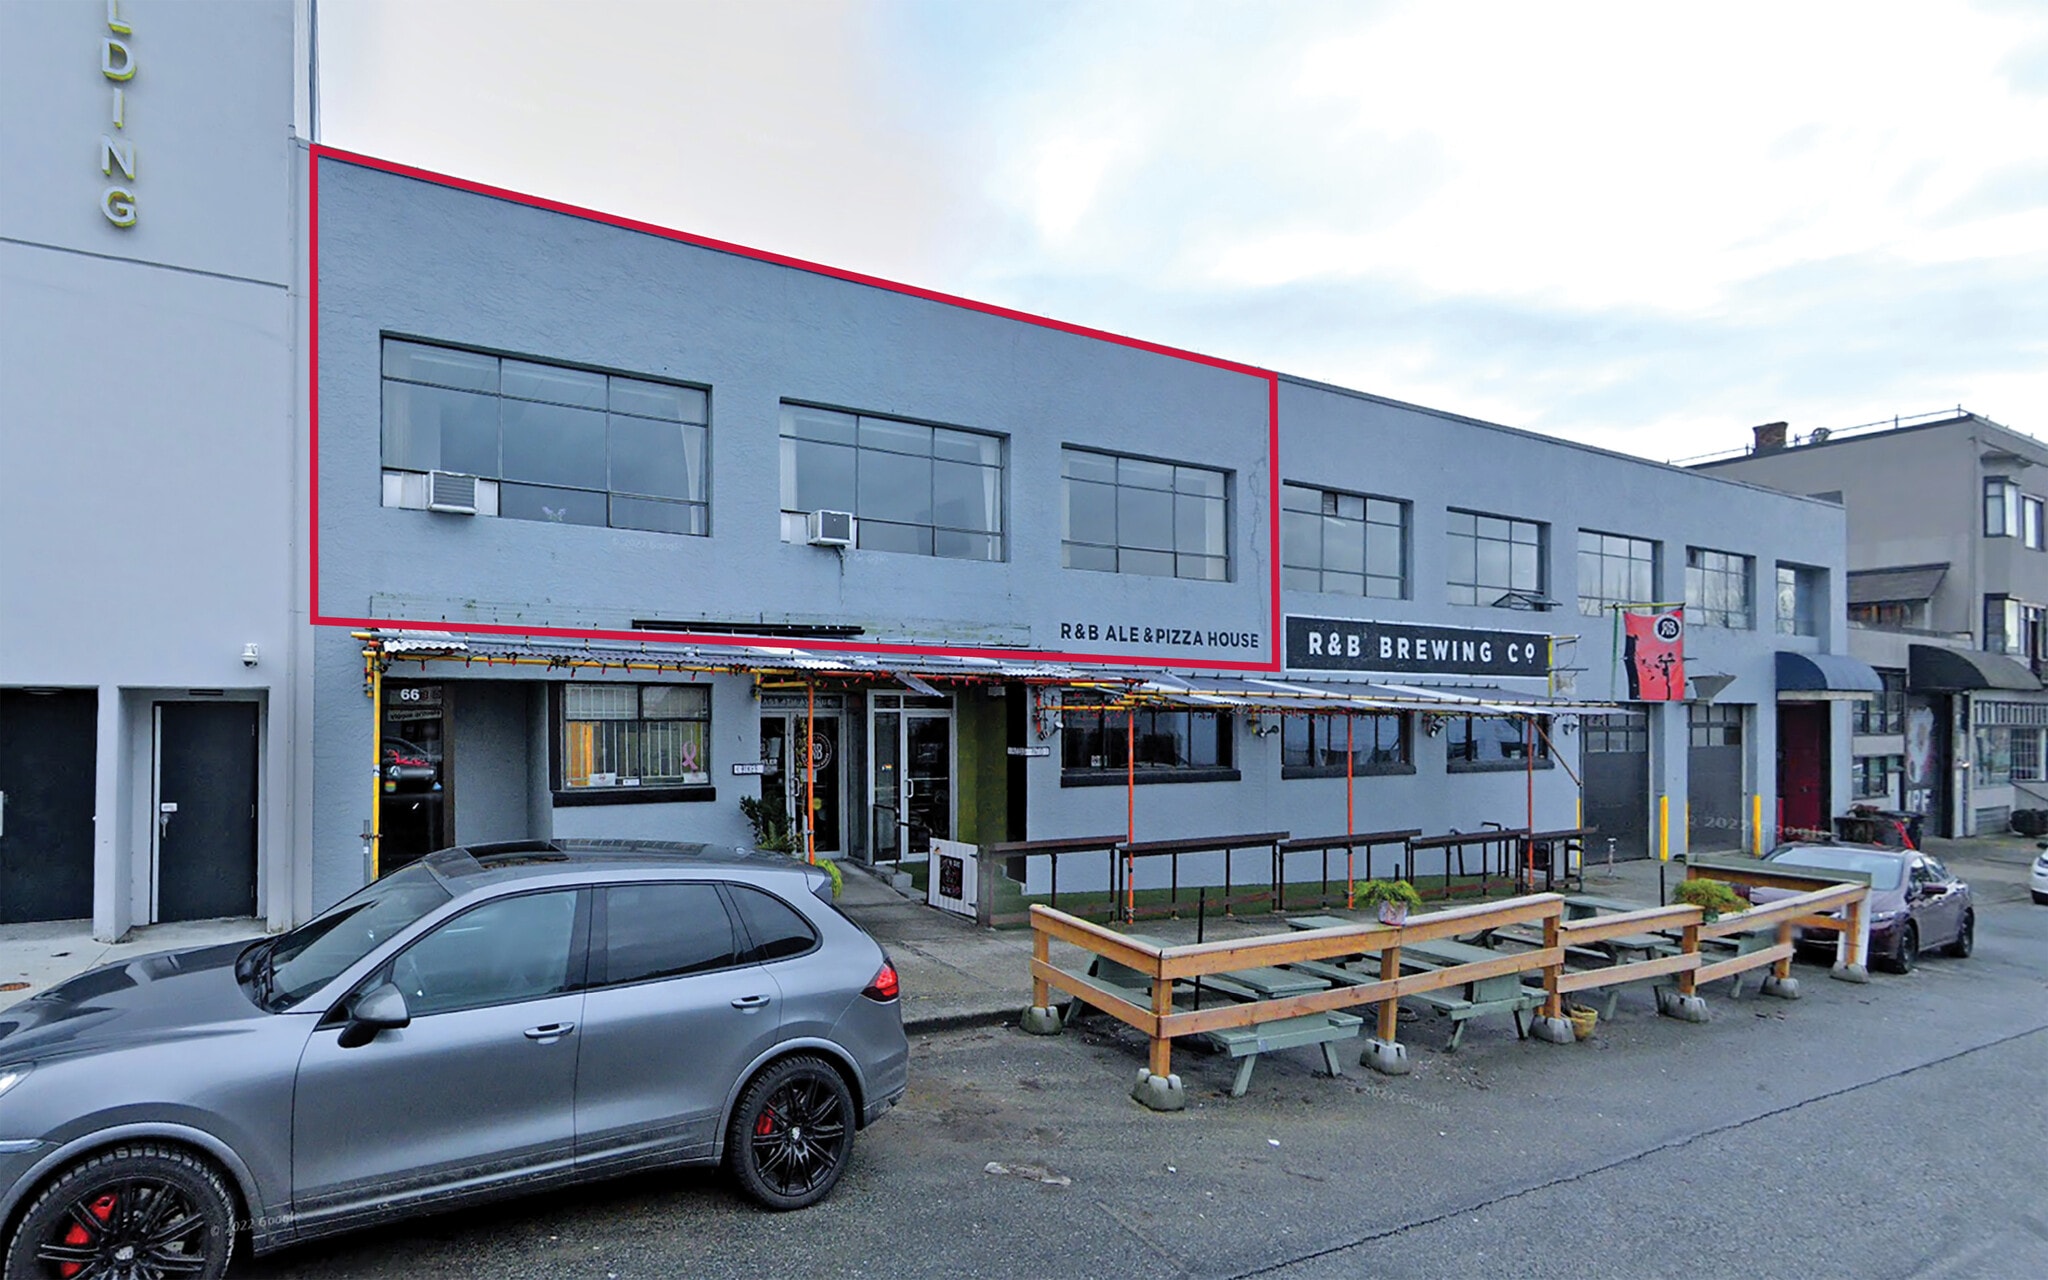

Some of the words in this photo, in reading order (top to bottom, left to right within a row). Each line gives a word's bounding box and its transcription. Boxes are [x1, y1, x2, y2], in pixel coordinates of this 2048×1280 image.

[1060, 622, 1099, 640] R&B
[1207, 631, 1259, 648] HOUSE
[1308, 631, 1361, 657] R&B
[1379, 636, 1493, 663] BREWING
[400, 688, 420, 700] 66
